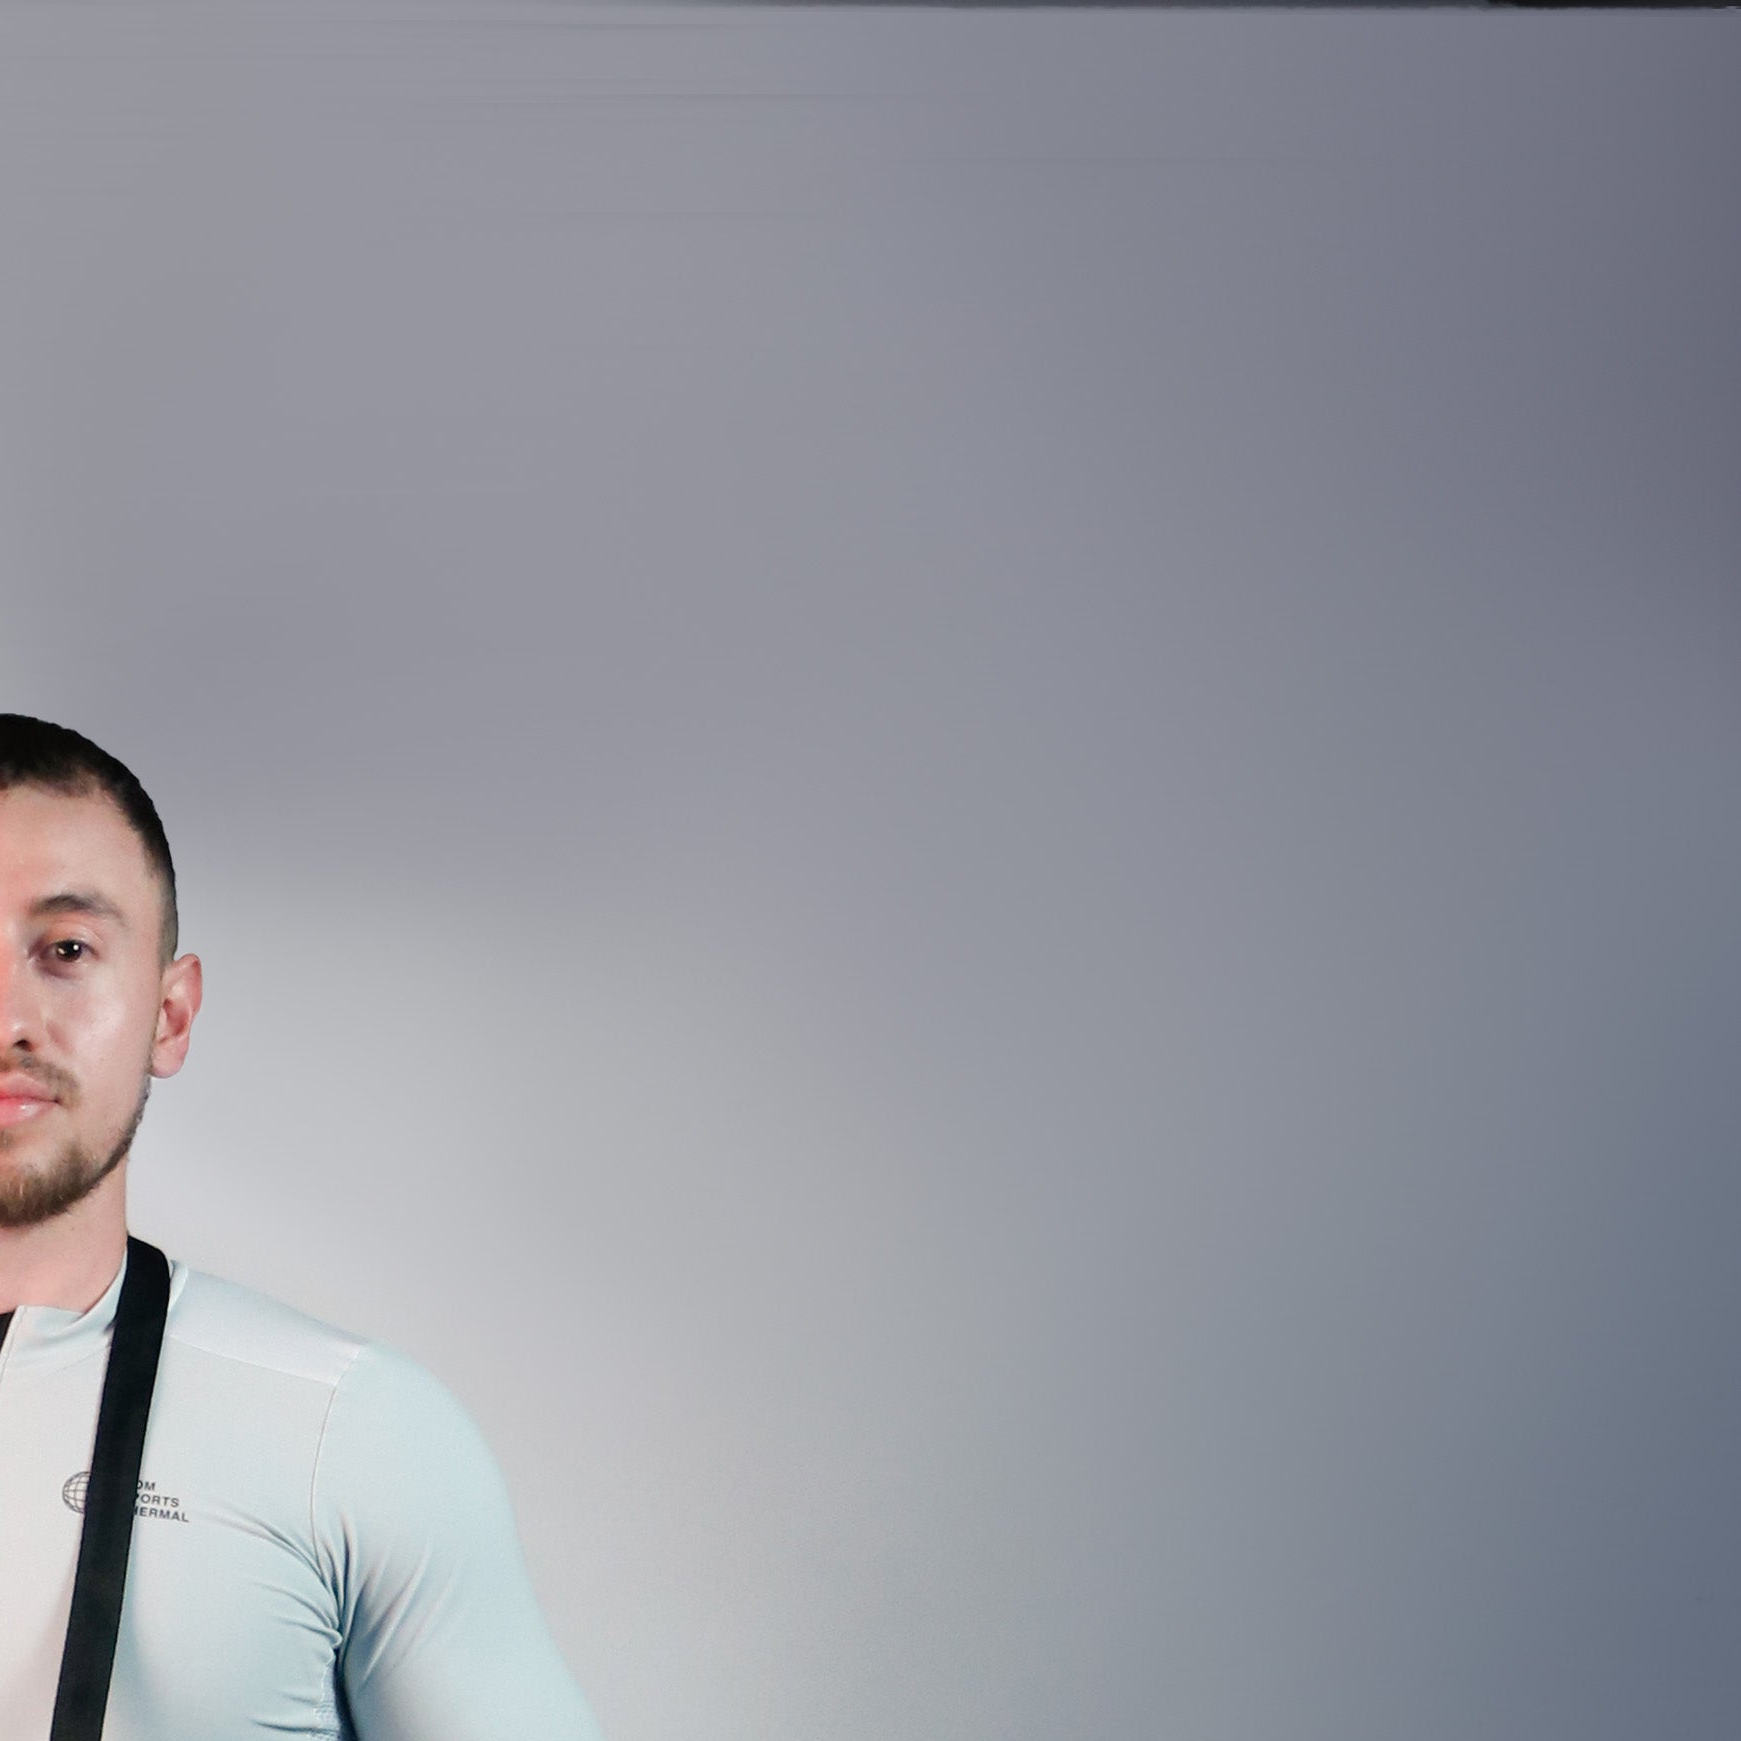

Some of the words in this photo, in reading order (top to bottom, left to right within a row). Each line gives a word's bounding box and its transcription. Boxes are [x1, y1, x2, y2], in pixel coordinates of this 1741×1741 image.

[136, 1480, 156, 1491] OM
[136, 1494, 180, 1507] ORTS
[133, 1507, 190, 1523] HERMAL
